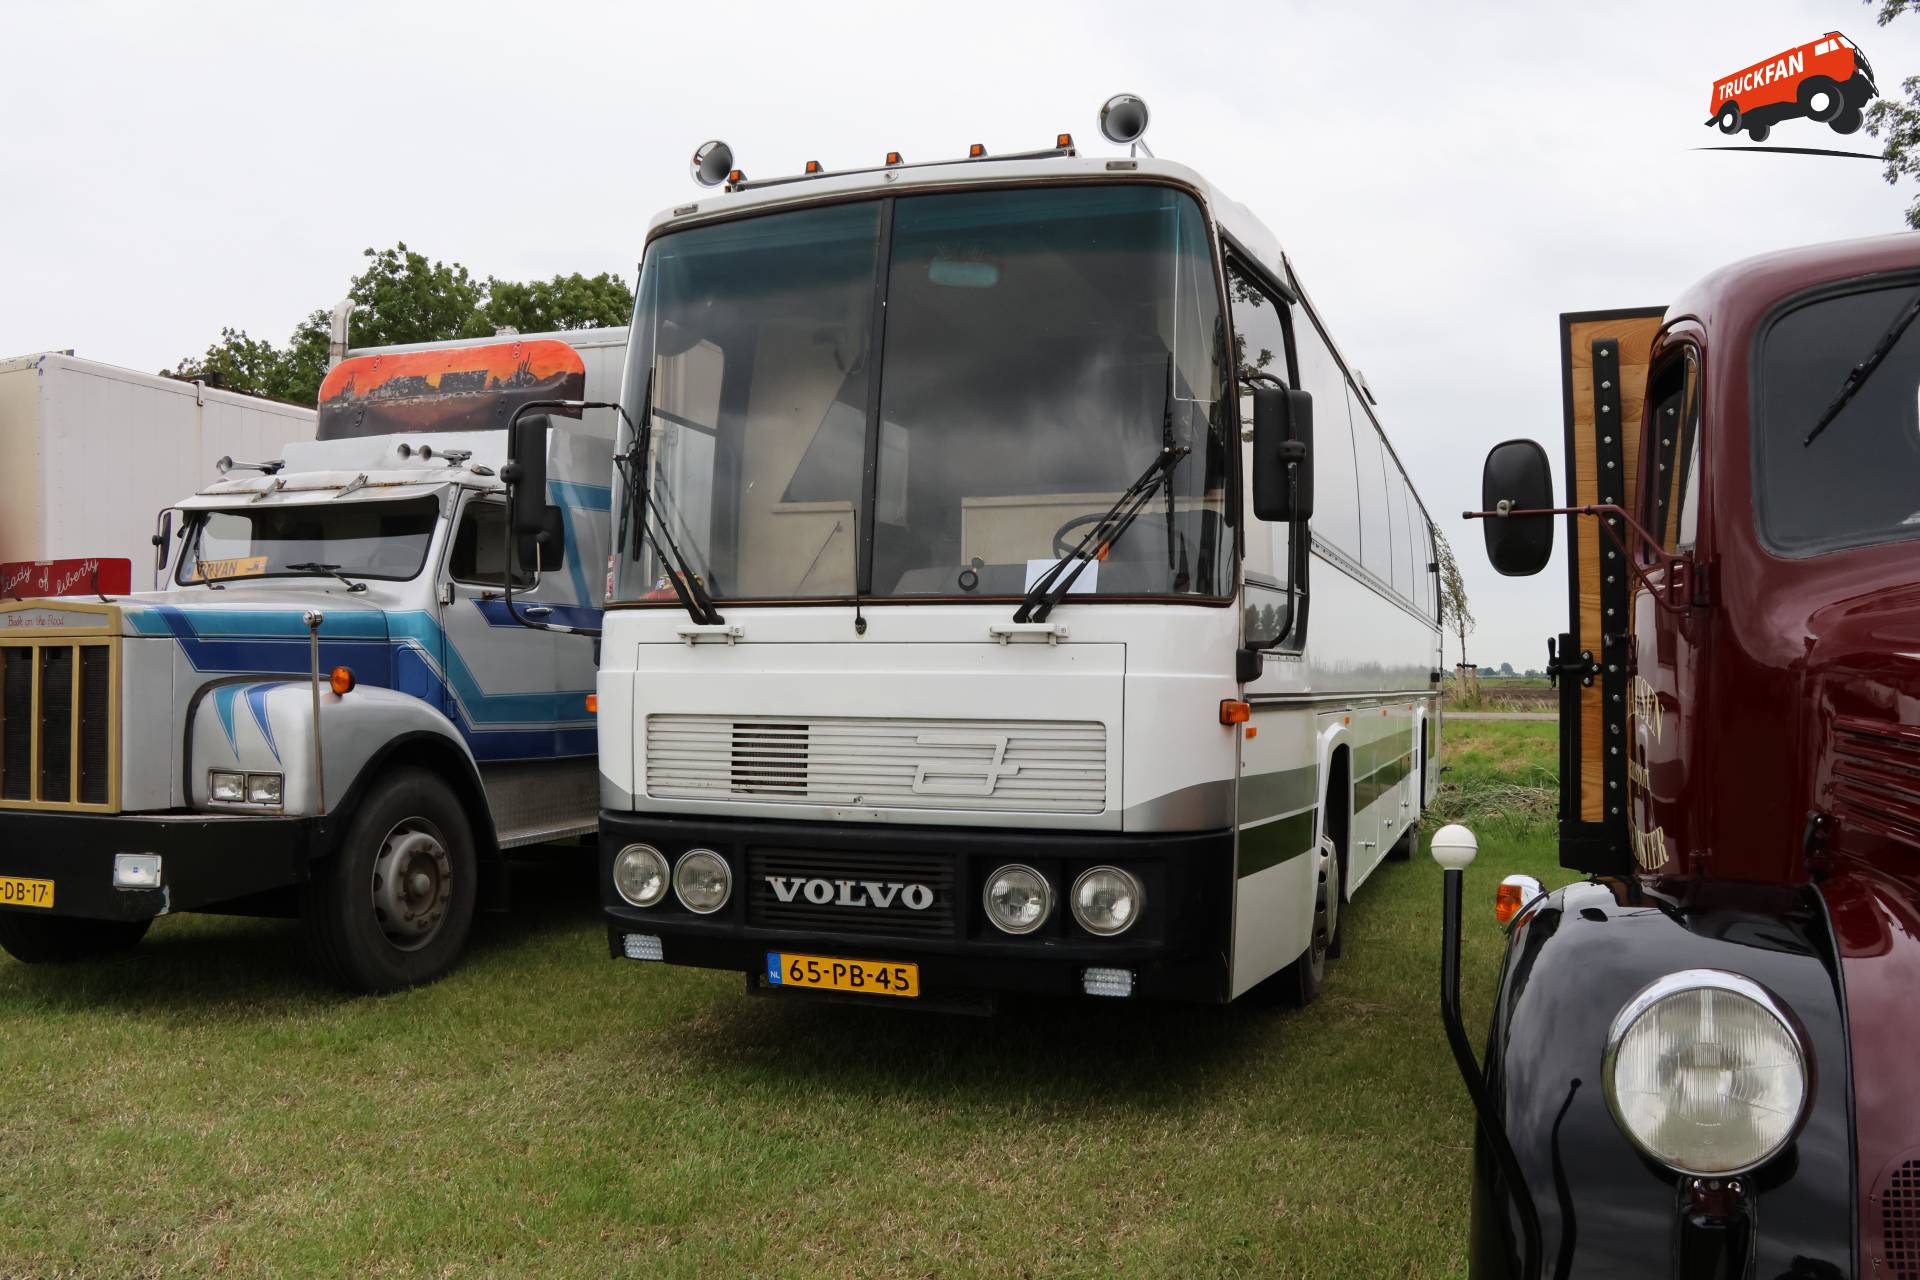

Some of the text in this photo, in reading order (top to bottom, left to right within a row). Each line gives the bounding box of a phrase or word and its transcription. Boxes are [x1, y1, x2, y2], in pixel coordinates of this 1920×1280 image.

[765, 876, 934, 910] VOLVO
[770, 970, 781, 980] NL
[789, 960, 910, 991] 65-PB-45
